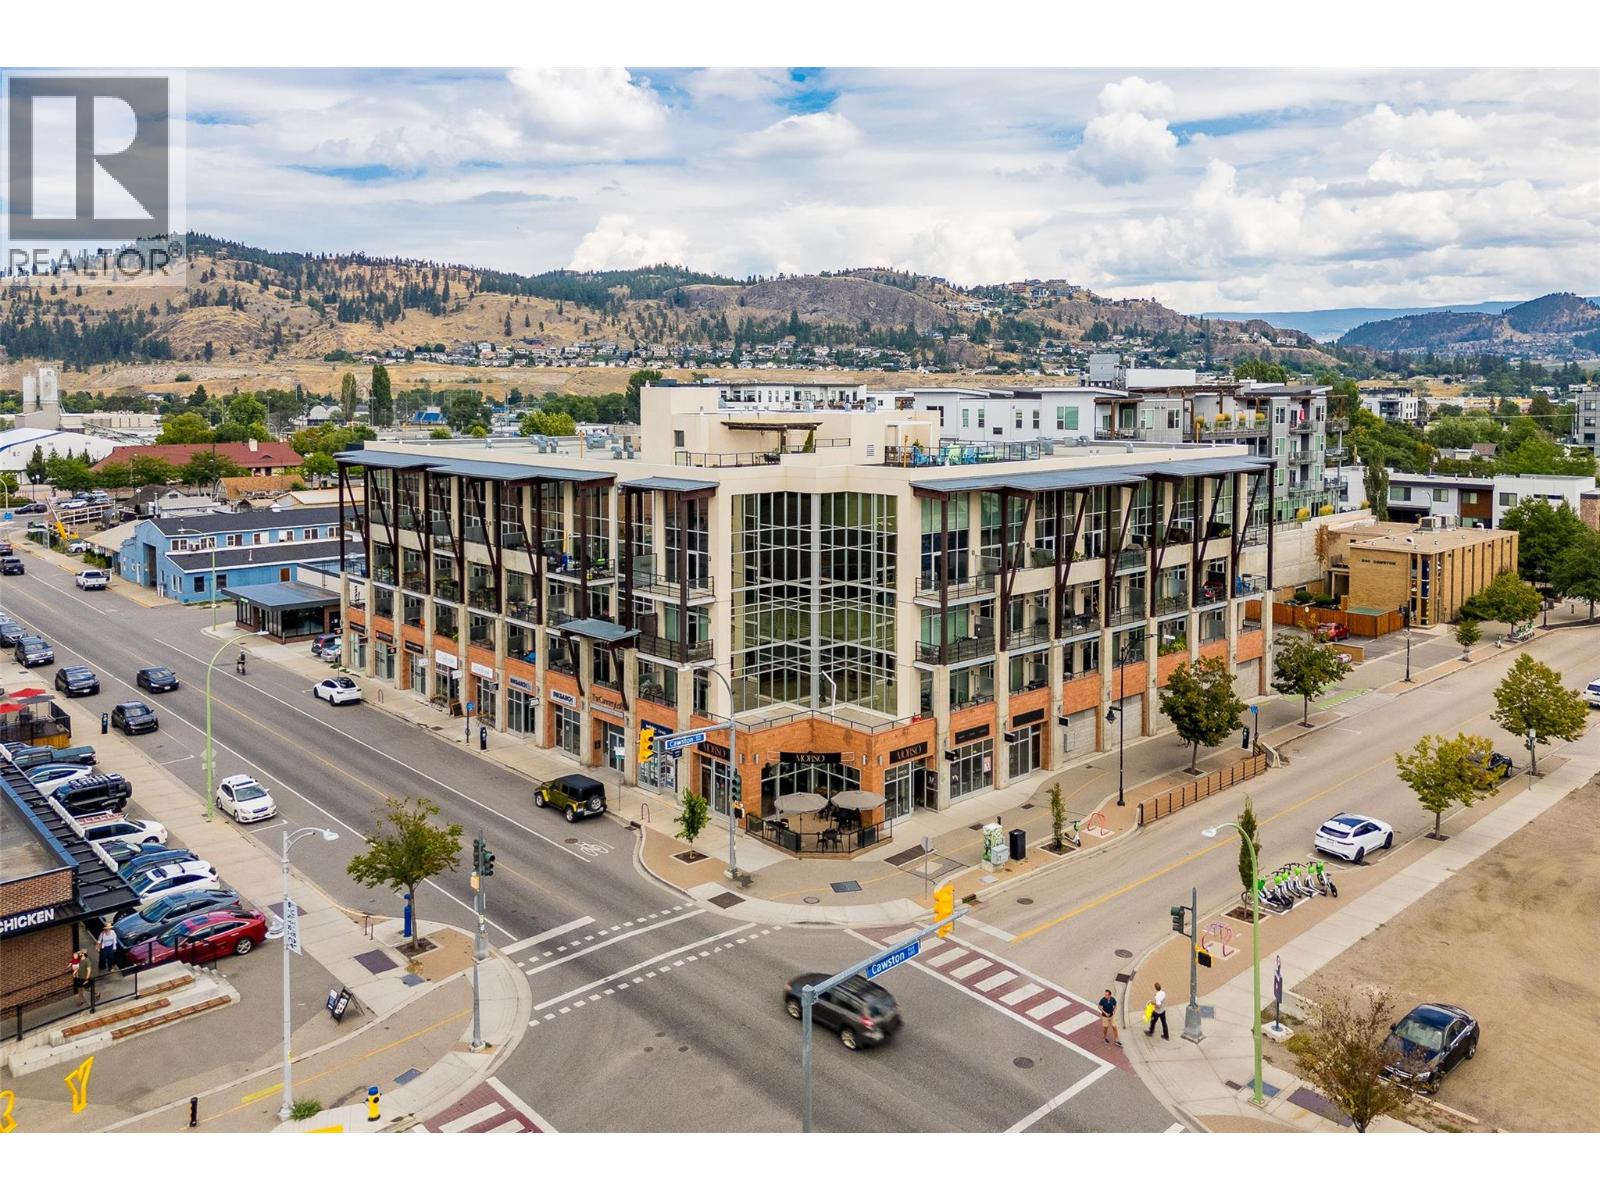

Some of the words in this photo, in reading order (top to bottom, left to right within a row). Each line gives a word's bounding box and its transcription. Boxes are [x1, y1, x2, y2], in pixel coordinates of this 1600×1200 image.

[669, 737, 694, 748] Cawston
[0, 908, 55, 934] CHICKEN
[872, 952, 905, 975] Cawston
